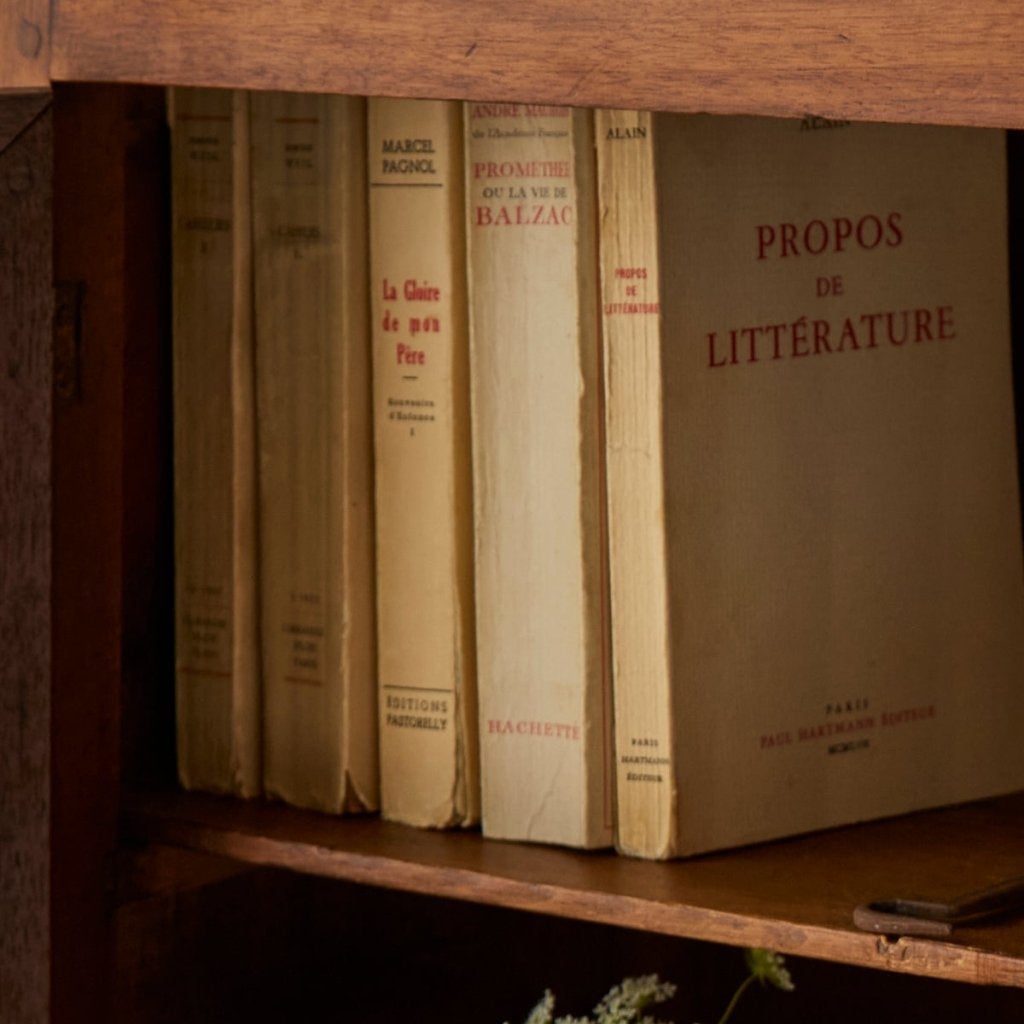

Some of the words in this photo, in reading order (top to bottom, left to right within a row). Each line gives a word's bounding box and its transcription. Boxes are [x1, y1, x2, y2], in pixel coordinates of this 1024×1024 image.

[606, 127, 647, 141] ALAIN
[382, 138, 435, 154] MARCEL
[382, 159, 436, 174] PAGNOL
[483, 187, 502, 199] OU
[508, 187, 526, 199] LA
[531, 187, 550, 198] VIE
[554, 187, 567, 199] DE
[476, 205, 573, 226] BALZAC
[756, 212, 903, 260] PROPOS
[615, 267, 647, 279] PROPOS
[382, 279, 397, 300] La
[404, 279, 440, 301] Gloire
[816, 276, 844, 297] DE
[382, 311, 399, 332] de
[706, 306, 957, 367] LITTÉRATURE
[396, 343, 425, 364] Père
[826, 698, 870, 715] PARIS
[488, 719, 581, 741] HACHETTE
